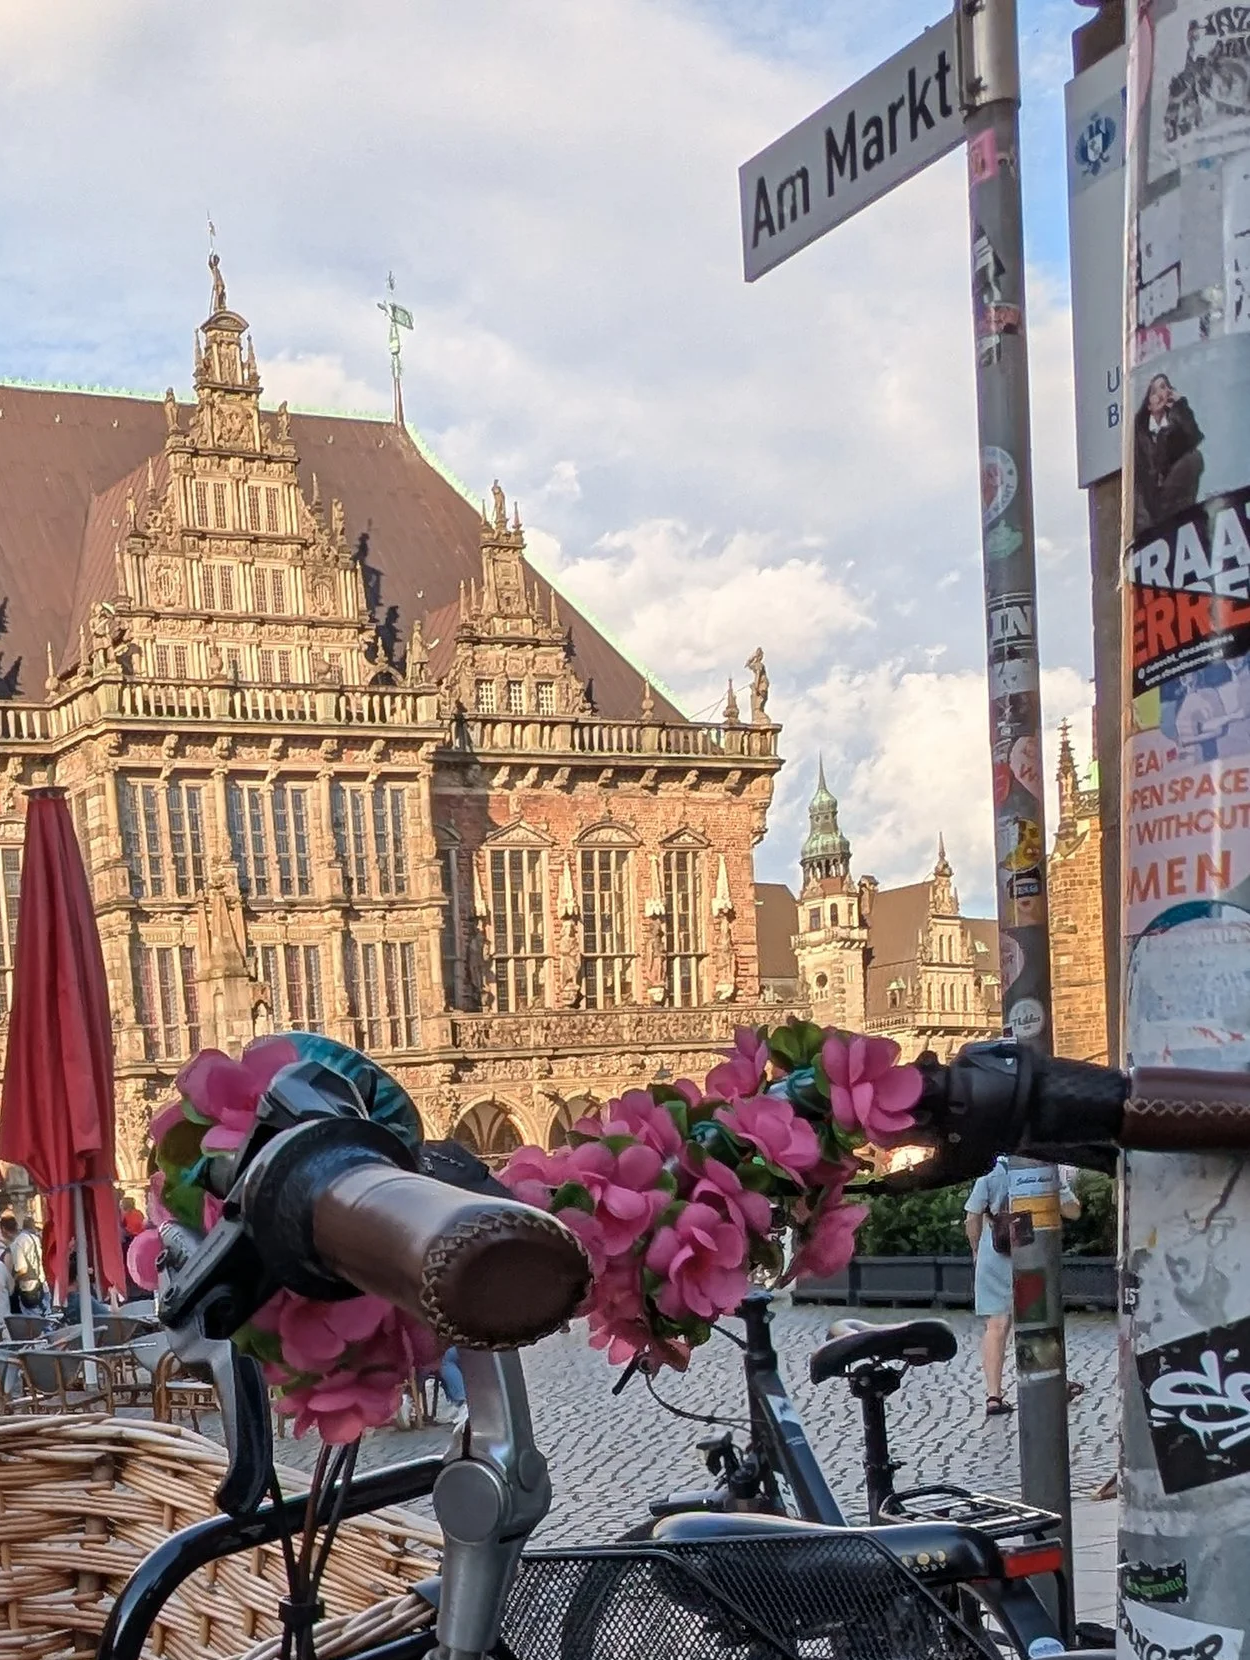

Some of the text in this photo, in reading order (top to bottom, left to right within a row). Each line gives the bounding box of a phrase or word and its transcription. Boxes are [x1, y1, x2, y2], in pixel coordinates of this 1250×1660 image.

[753, 50, 953, 249] Am Markt
[1130, 782, 1164, 813] PEN
